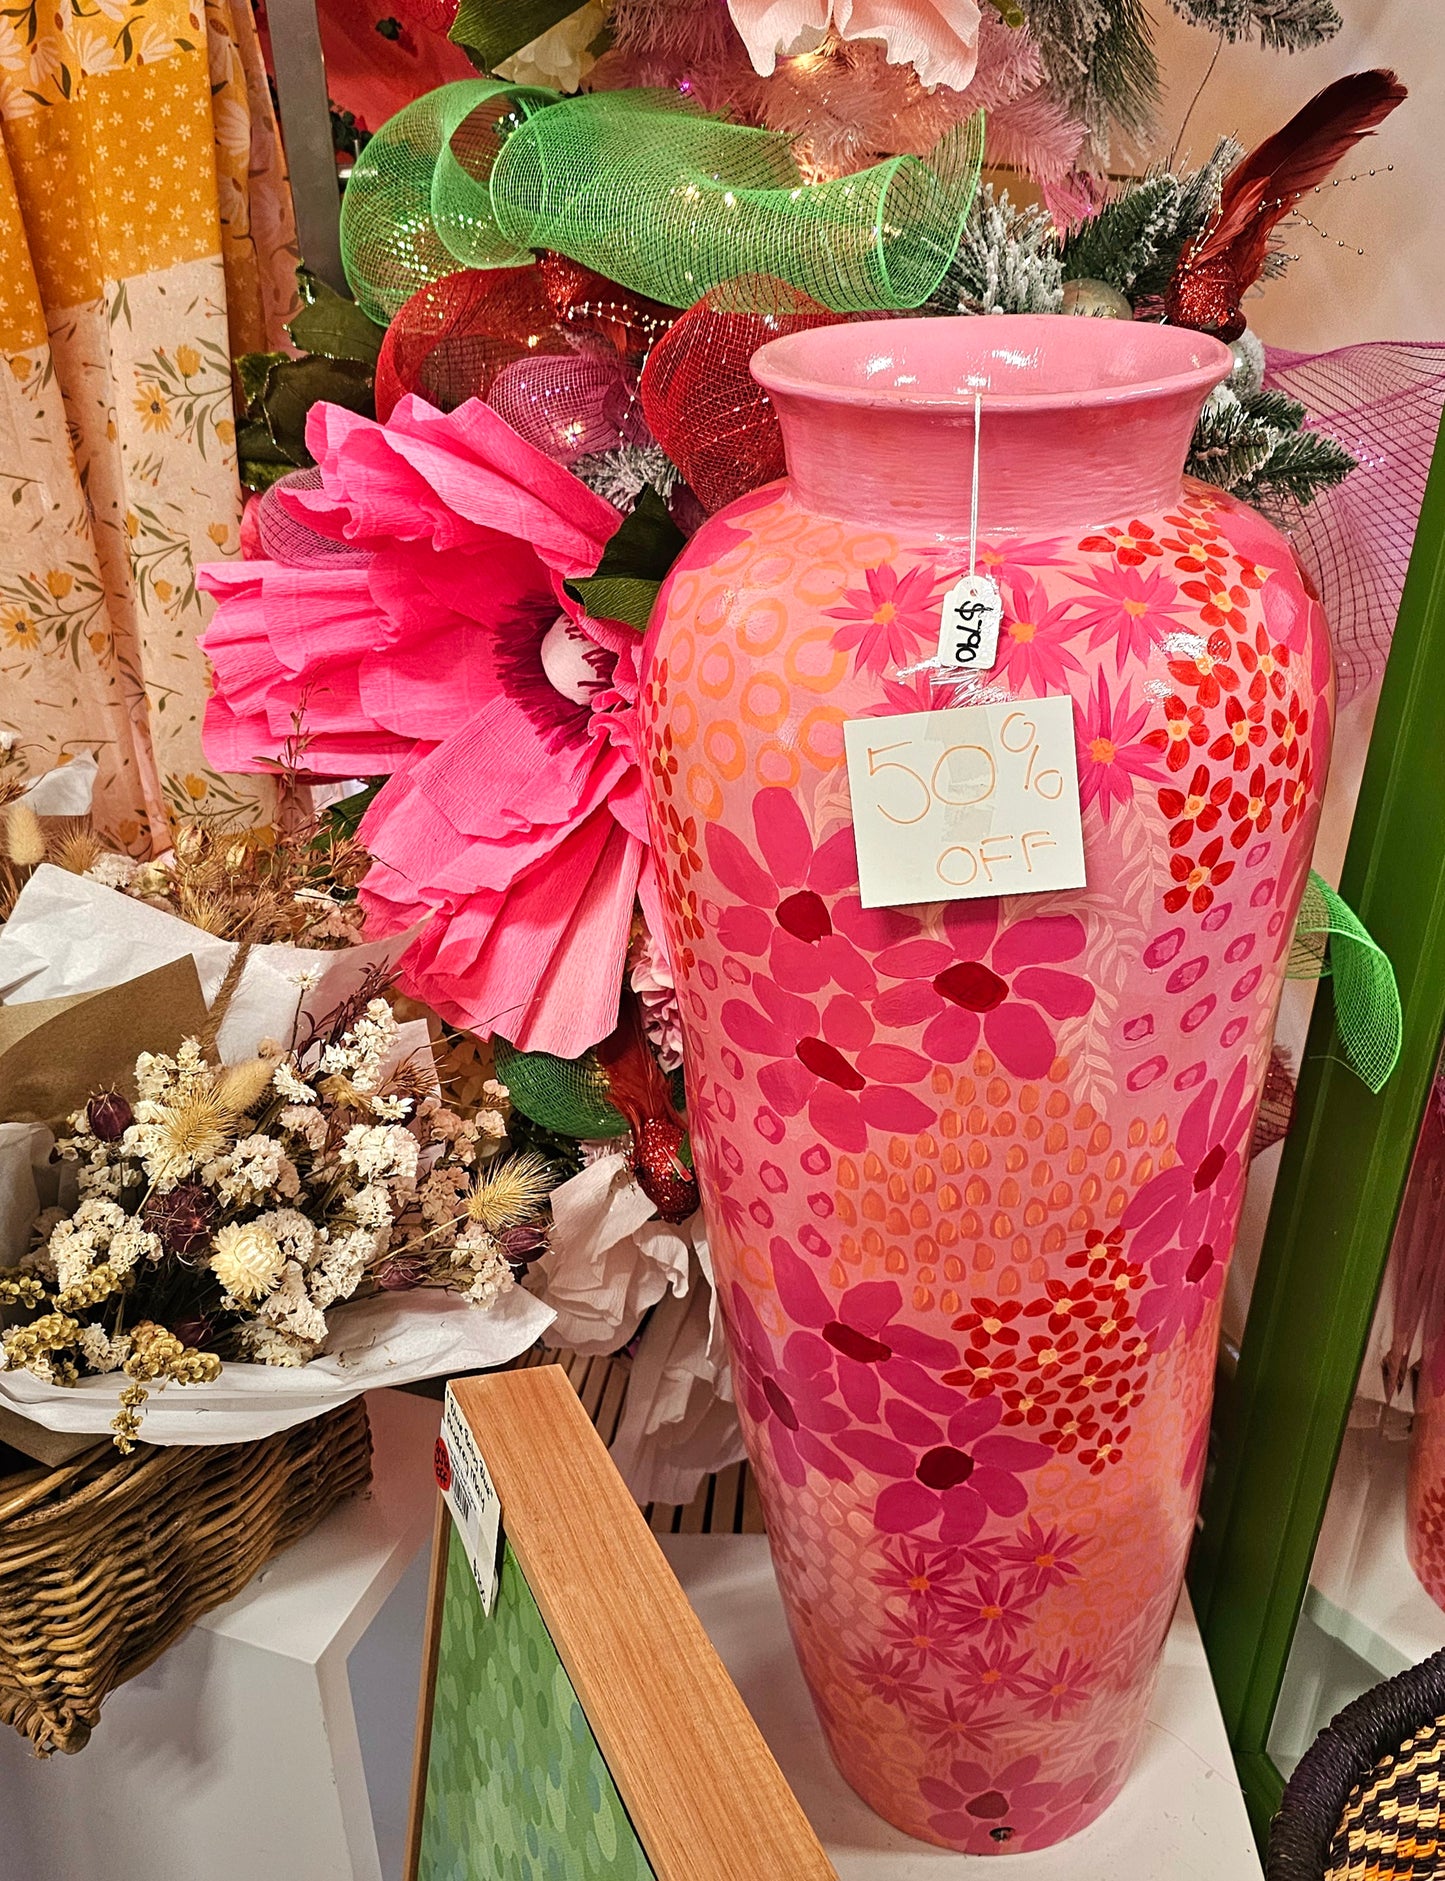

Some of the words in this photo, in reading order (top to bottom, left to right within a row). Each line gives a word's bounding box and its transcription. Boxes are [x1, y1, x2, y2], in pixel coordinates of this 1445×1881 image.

[954, 600, 995, 663] $790
[867, 712, 1063, 824] 50%
[936, 831, 1057, 886] OFF
